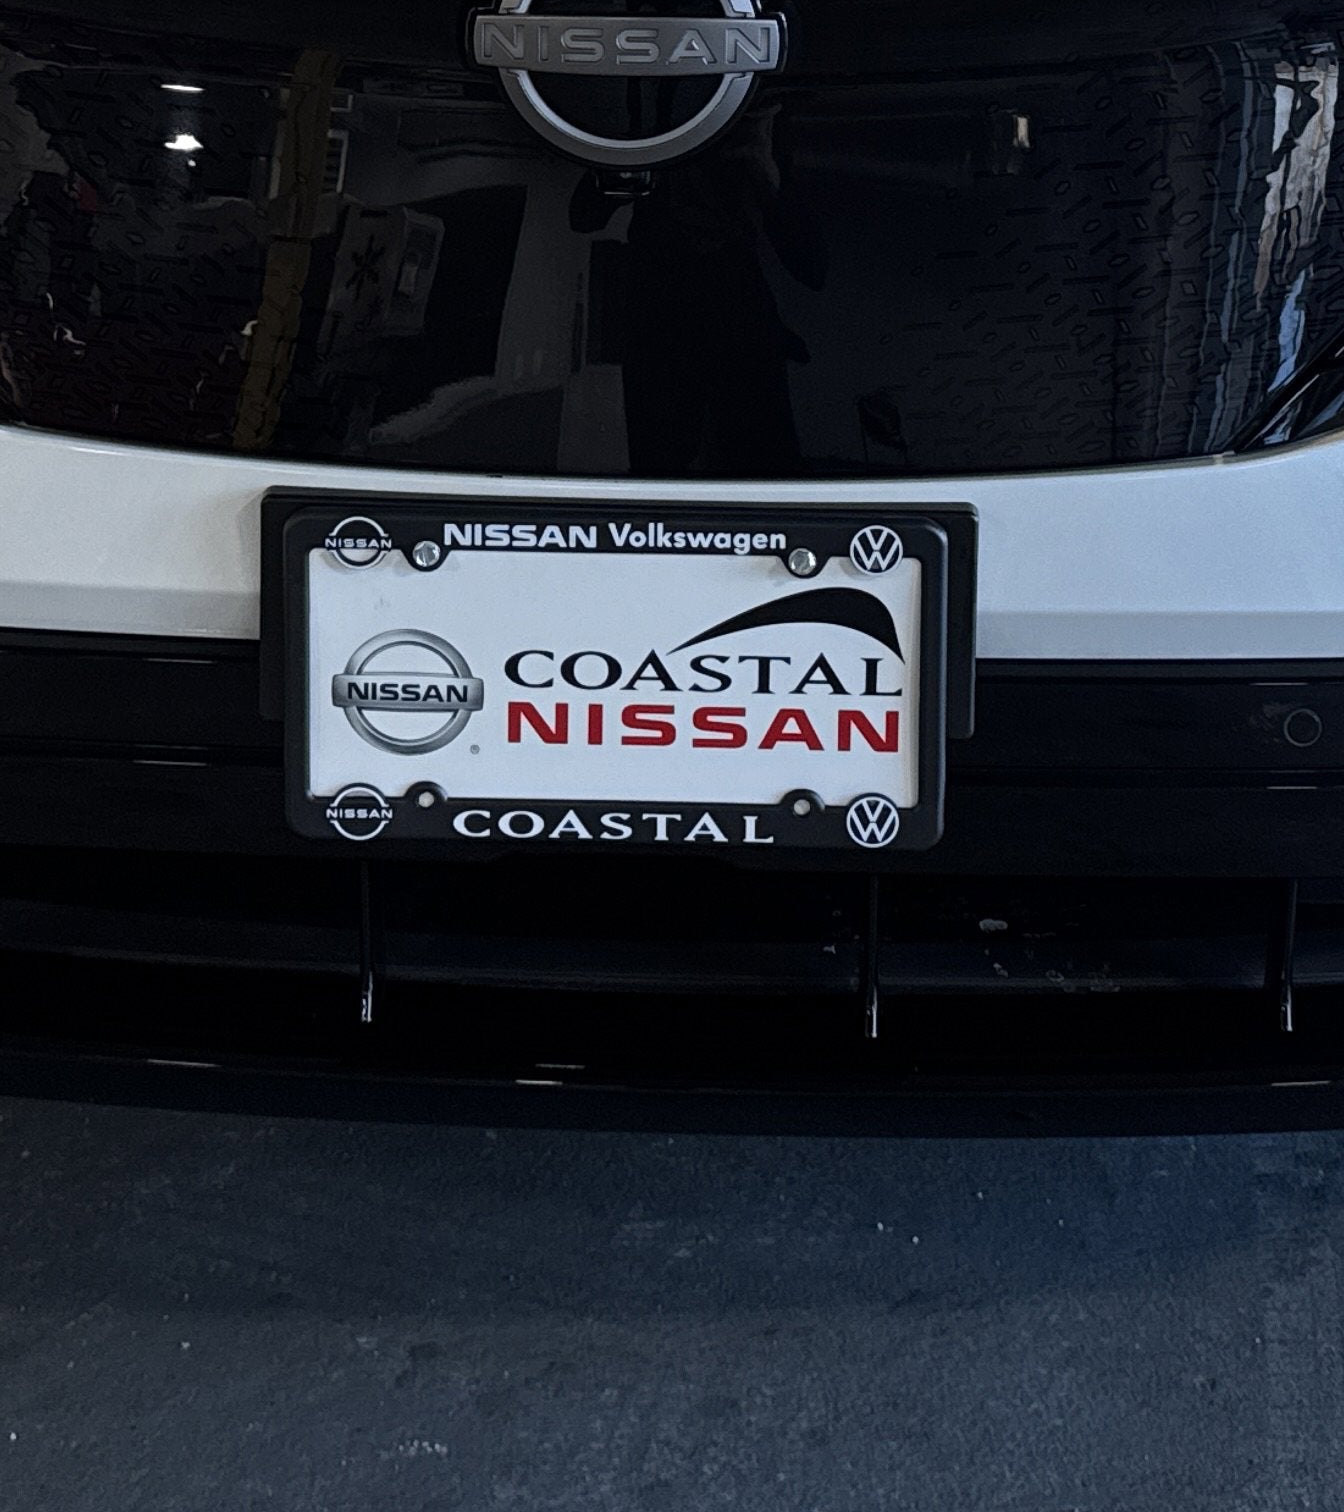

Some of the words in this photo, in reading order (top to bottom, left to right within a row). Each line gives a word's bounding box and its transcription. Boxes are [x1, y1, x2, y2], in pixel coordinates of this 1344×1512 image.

[480, 21, 771, 66] NISSAN
[324, 537, 392, 550] NISSAN
[443, 522, 598, 549] NISSAN
[607, 521, 788, 556] Volkswagen
[503, 647, 905, 697] COASTAL
[347, 681, 469, 703] NISSAN
[507, 701, 900, 753] NISSAN
[325, 807, 394, 821] NISSAN
[452, 808, 775, 845] COASTAL
